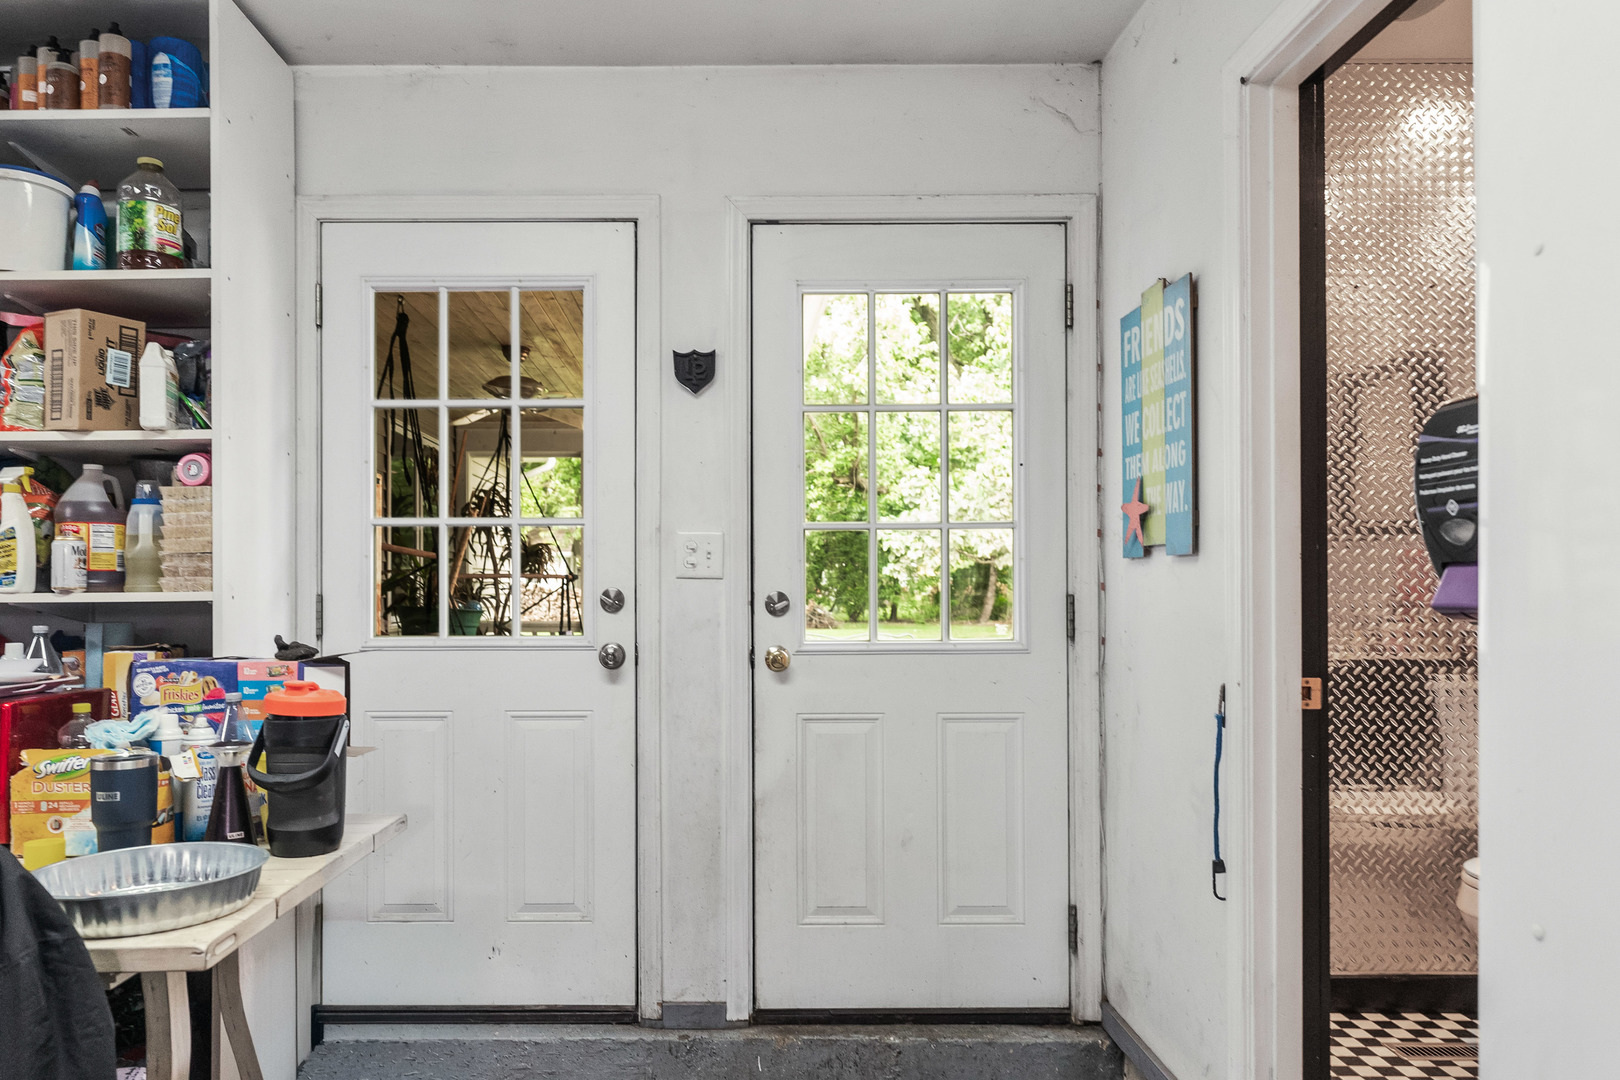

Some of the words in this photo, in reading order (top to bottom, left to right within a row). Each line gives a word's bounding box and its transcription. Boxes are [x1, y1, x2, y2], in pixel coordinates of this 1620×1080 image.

[155, 205, 181, 224] Pine
[156, 218, 178, 235] Sol
[1123, 297, 1186, 368] FRIENDS
[97, 348, 106, 376] LIQUID
[1124, 373, 1137, 404] ARE
[1136, 364, 1152, 399] LIKE
[1124, 411, 1141, 446] WE
[1142, 390, 1187, 441] COLLECT
[1125, 451, 1150, 481] THEM
[1152, 440, 1186, 473] ALONG
[1146, 486, 1162, 516] THE
[1165, 479, 1188, 515] WAY.
[163, 688, 200, 701] Friskies
[36, 755, 91, 779] Swiffer
[48, 801, 59, 809] 24
